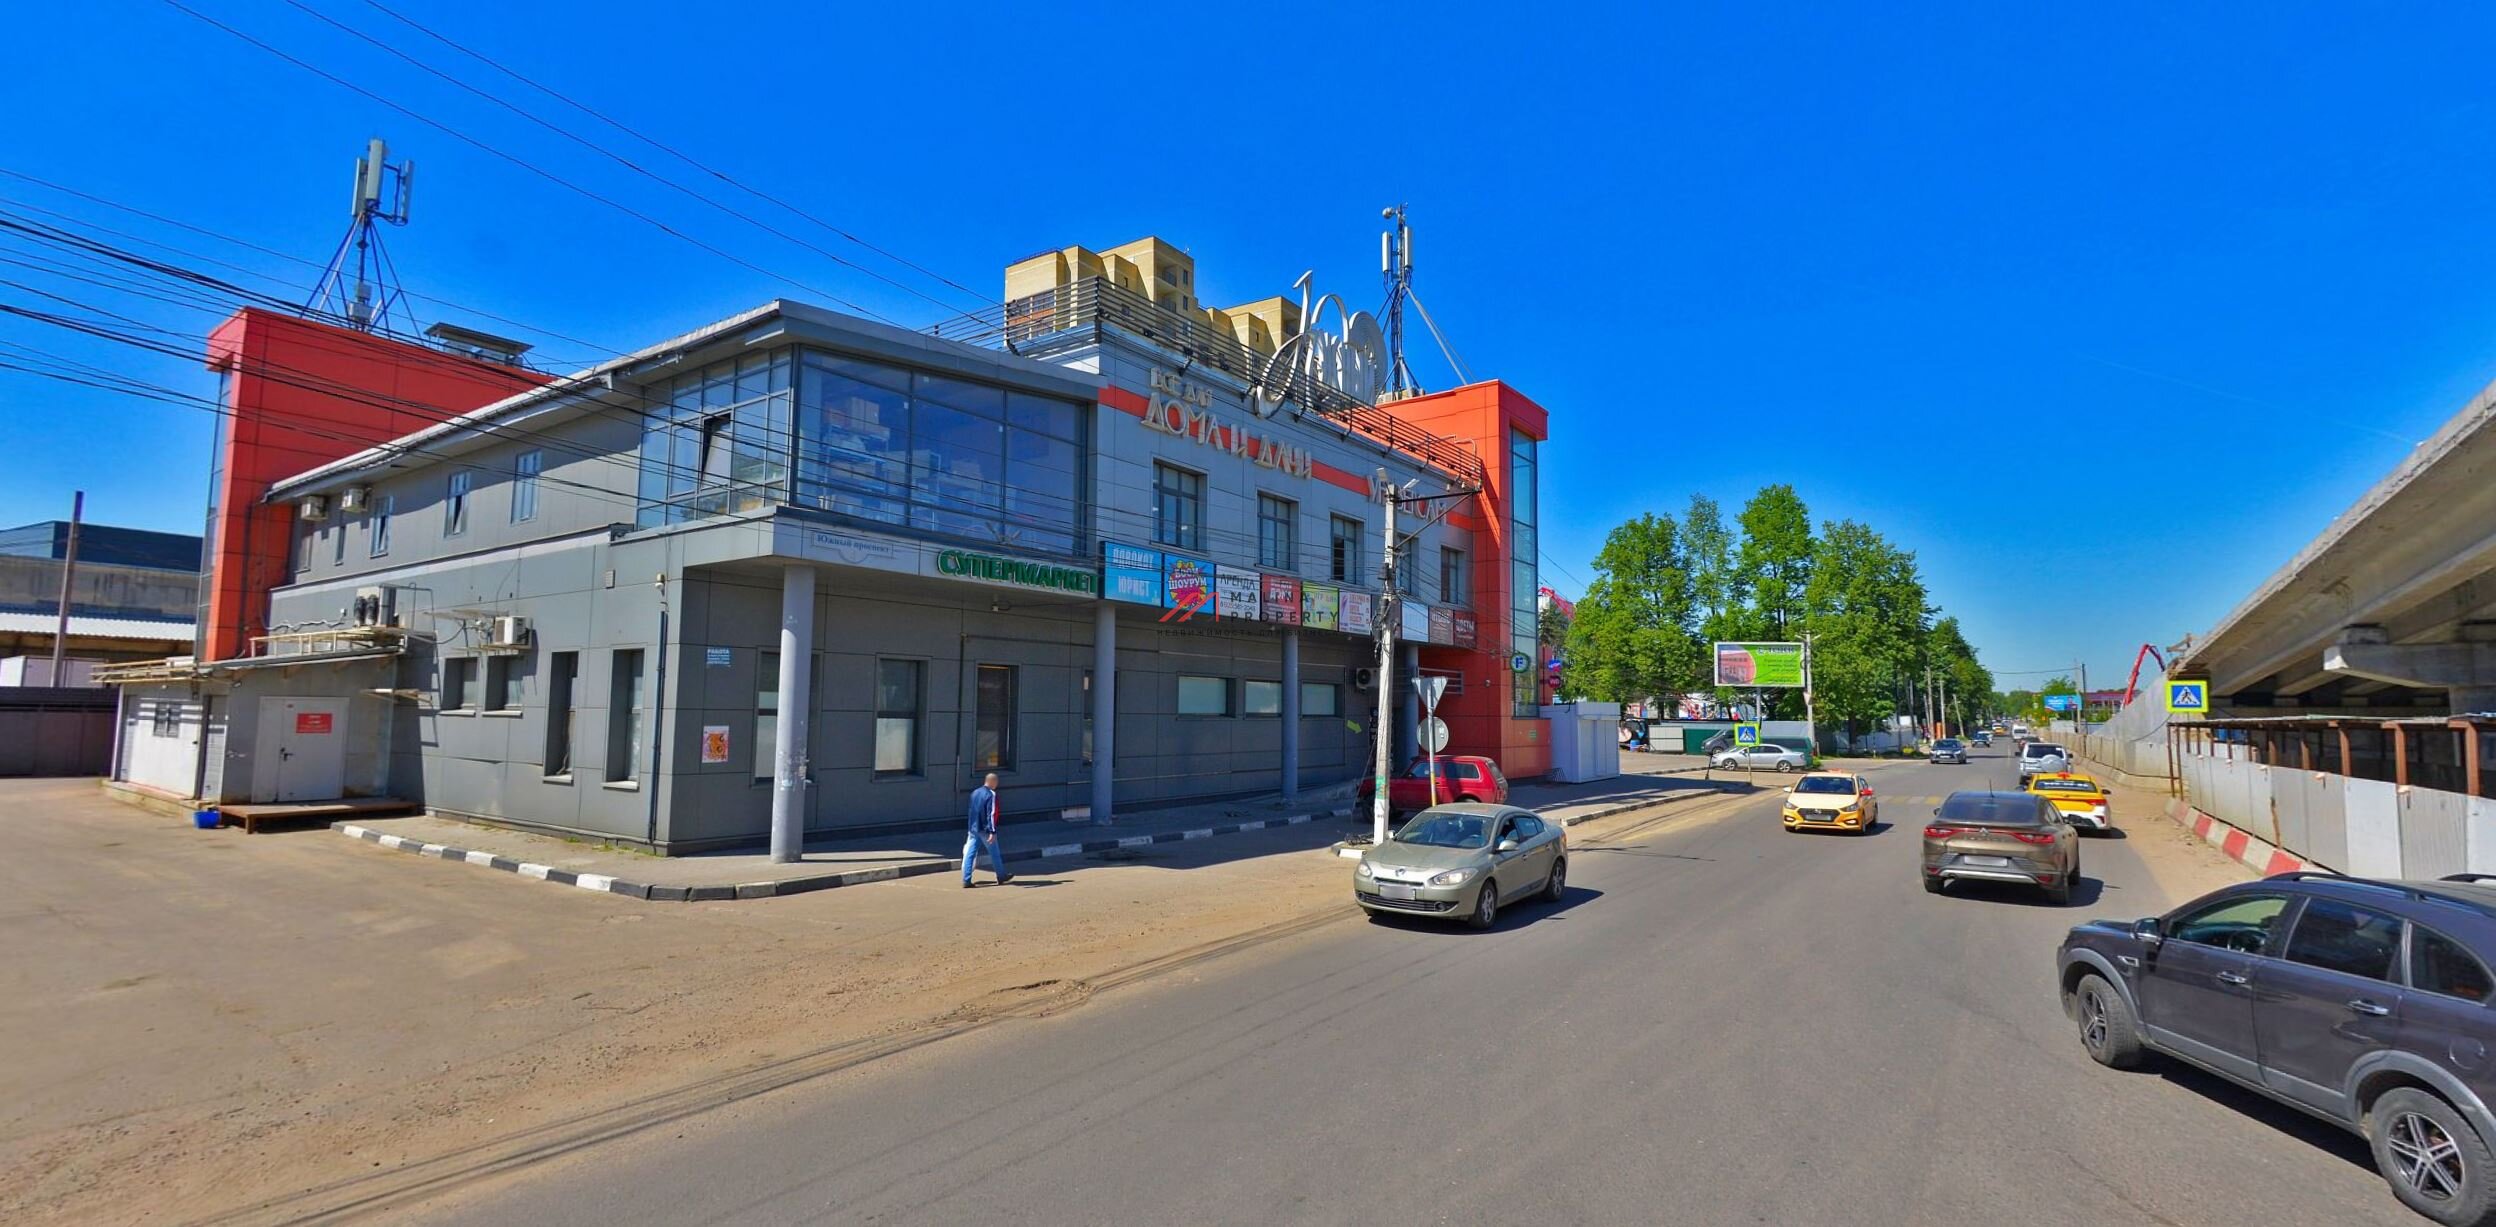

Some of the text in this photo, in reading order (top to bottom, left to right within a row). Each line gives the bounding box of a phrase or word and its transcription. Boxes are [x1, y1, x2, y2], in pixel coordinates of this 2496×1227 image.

[1151, 367, 1212, 408] ВСЕ ДЛЯ
[1141, 391, 1312, 480] ДОМА И ДАЧИ
[937, 549, 1098, 595] СУПЕРМАРКЕТ
[1168, 577, 1208, 591] ШОУРУМ
